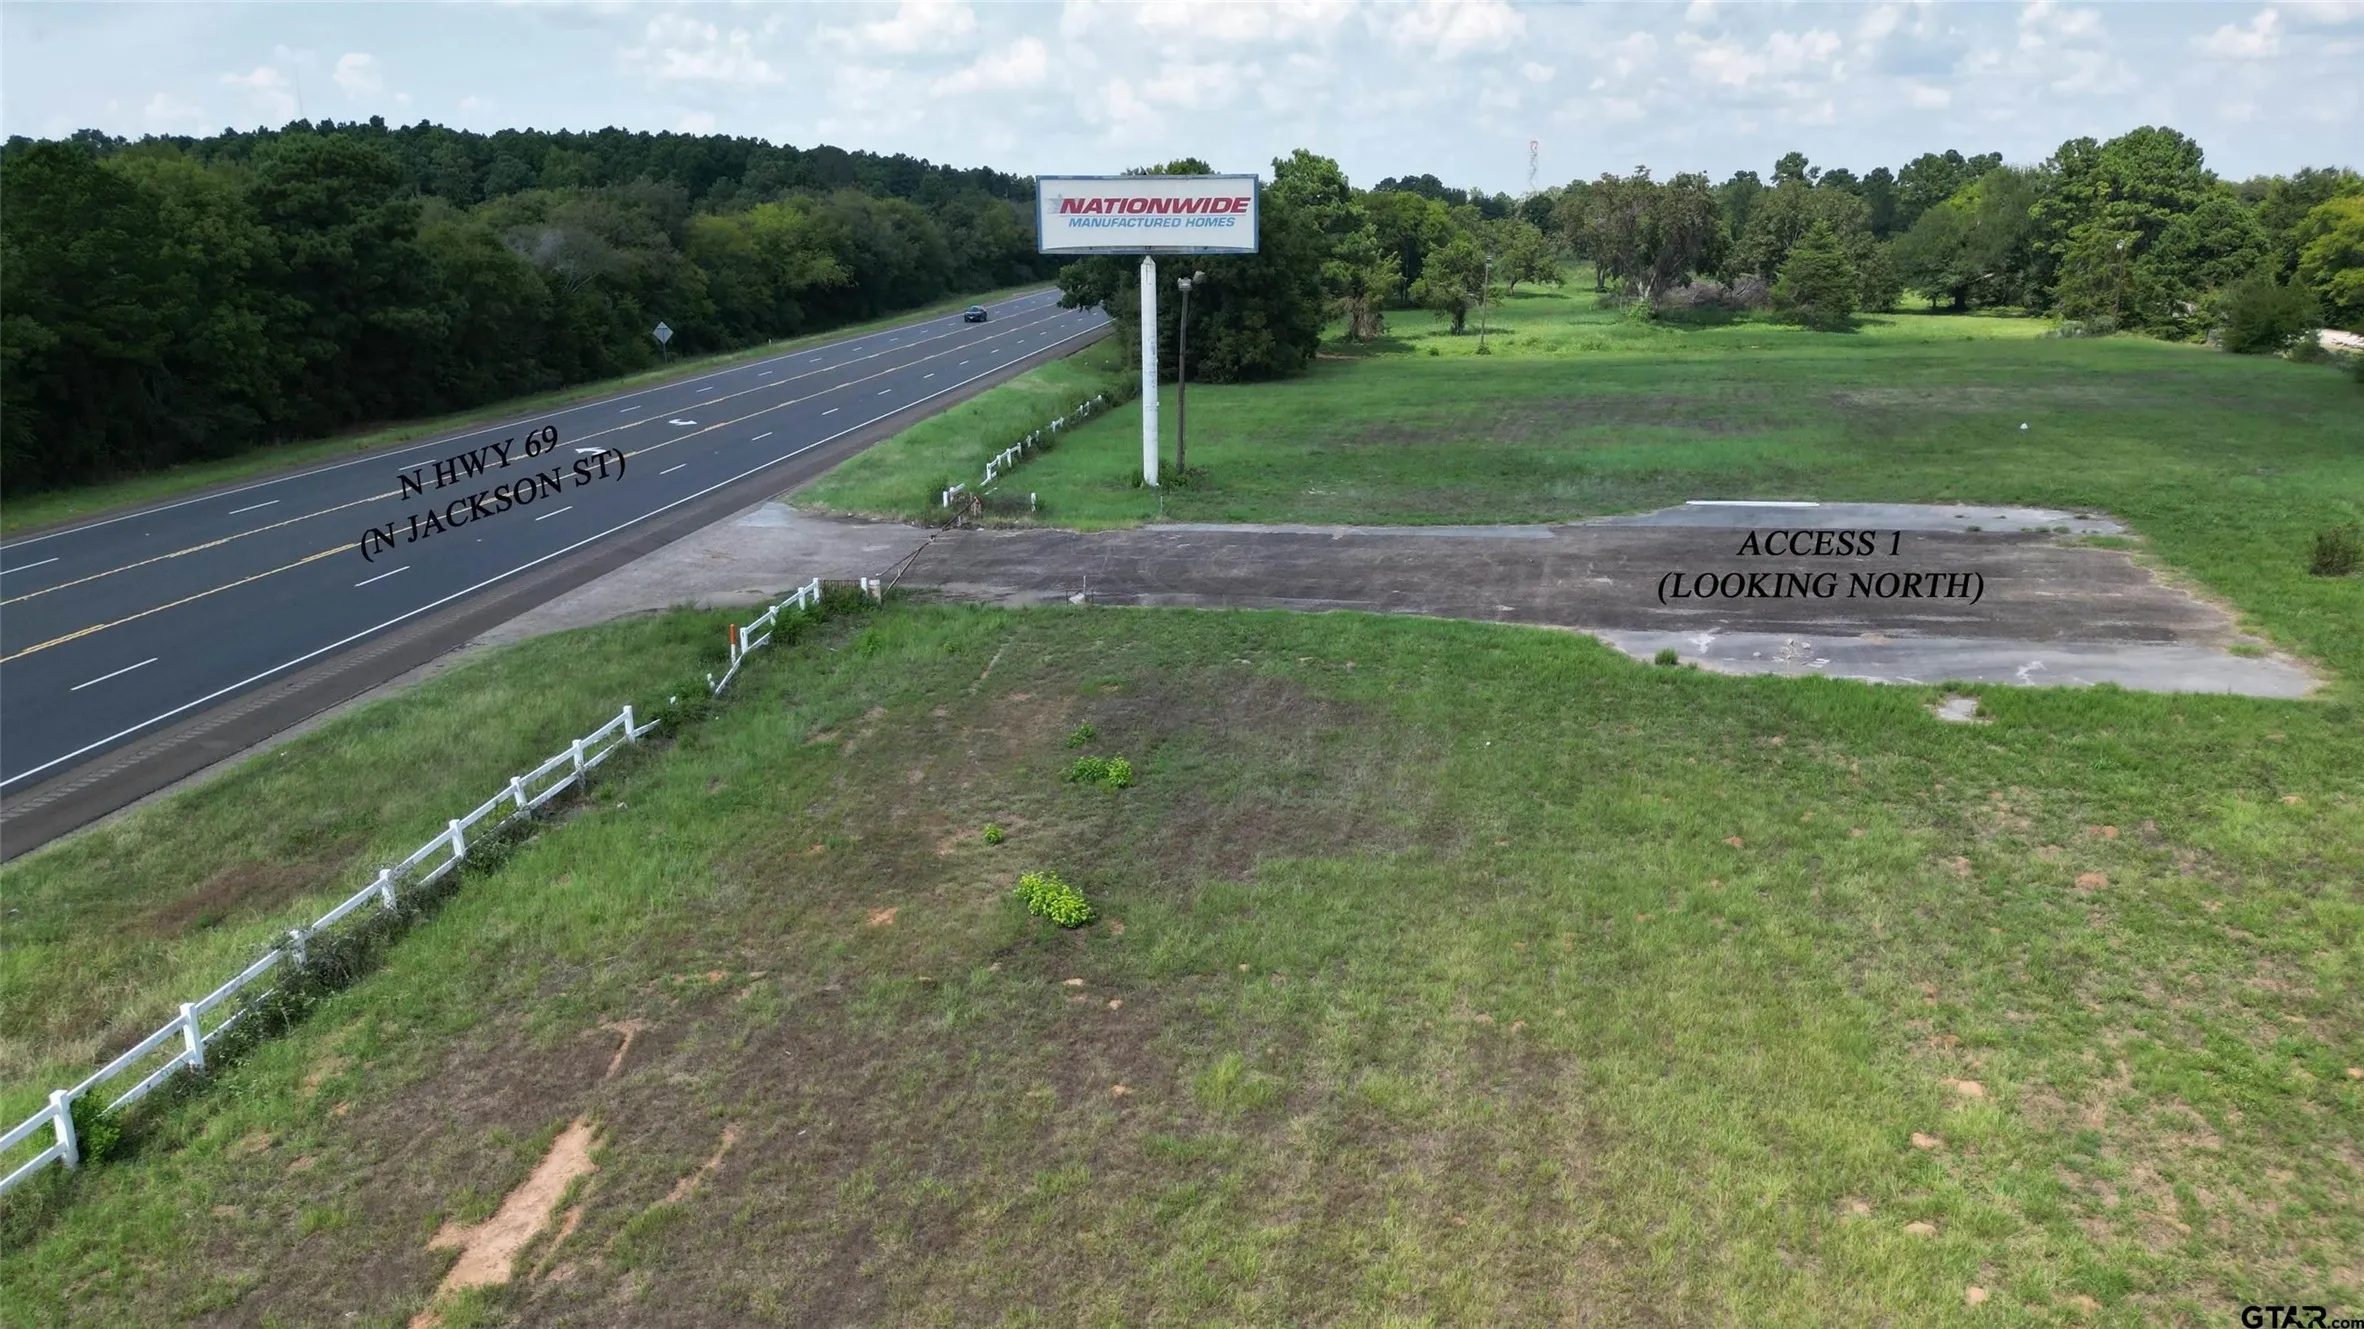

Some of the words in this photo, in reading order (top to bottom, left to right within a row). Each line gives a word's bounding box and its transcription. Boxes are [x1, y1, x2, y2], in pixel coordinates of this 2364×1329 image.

[1059, 197, 1251, 214] NATIONWIDE
[1068, 217, 1181, 228] MANUFACTURED
[1185, 216, 1236, 227] HOMES
